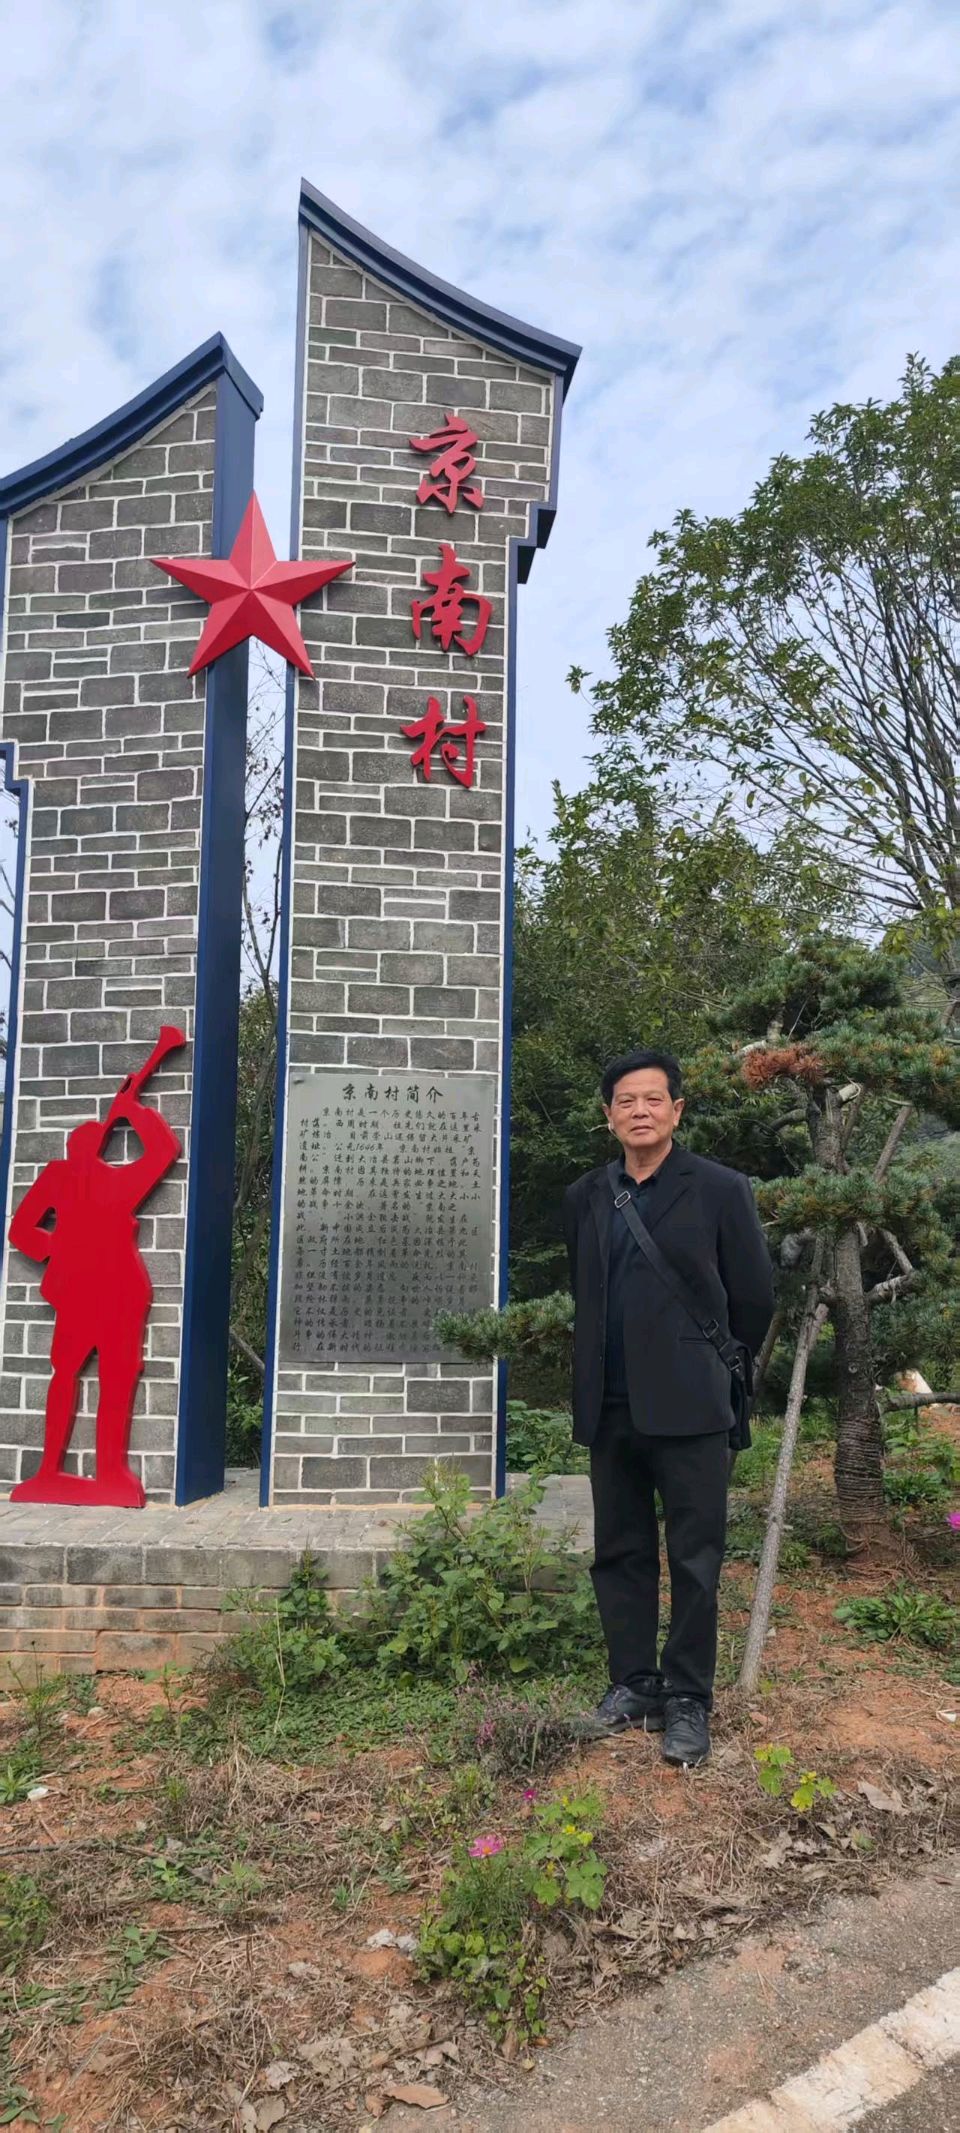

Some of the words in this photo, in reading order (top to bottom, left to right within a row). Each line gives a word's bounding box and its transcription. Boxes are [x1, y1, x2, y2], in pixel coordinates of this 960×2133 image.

[400, 412, 493, 789] 京南村
[342, 1082, 444, 1103] 京南村简介
